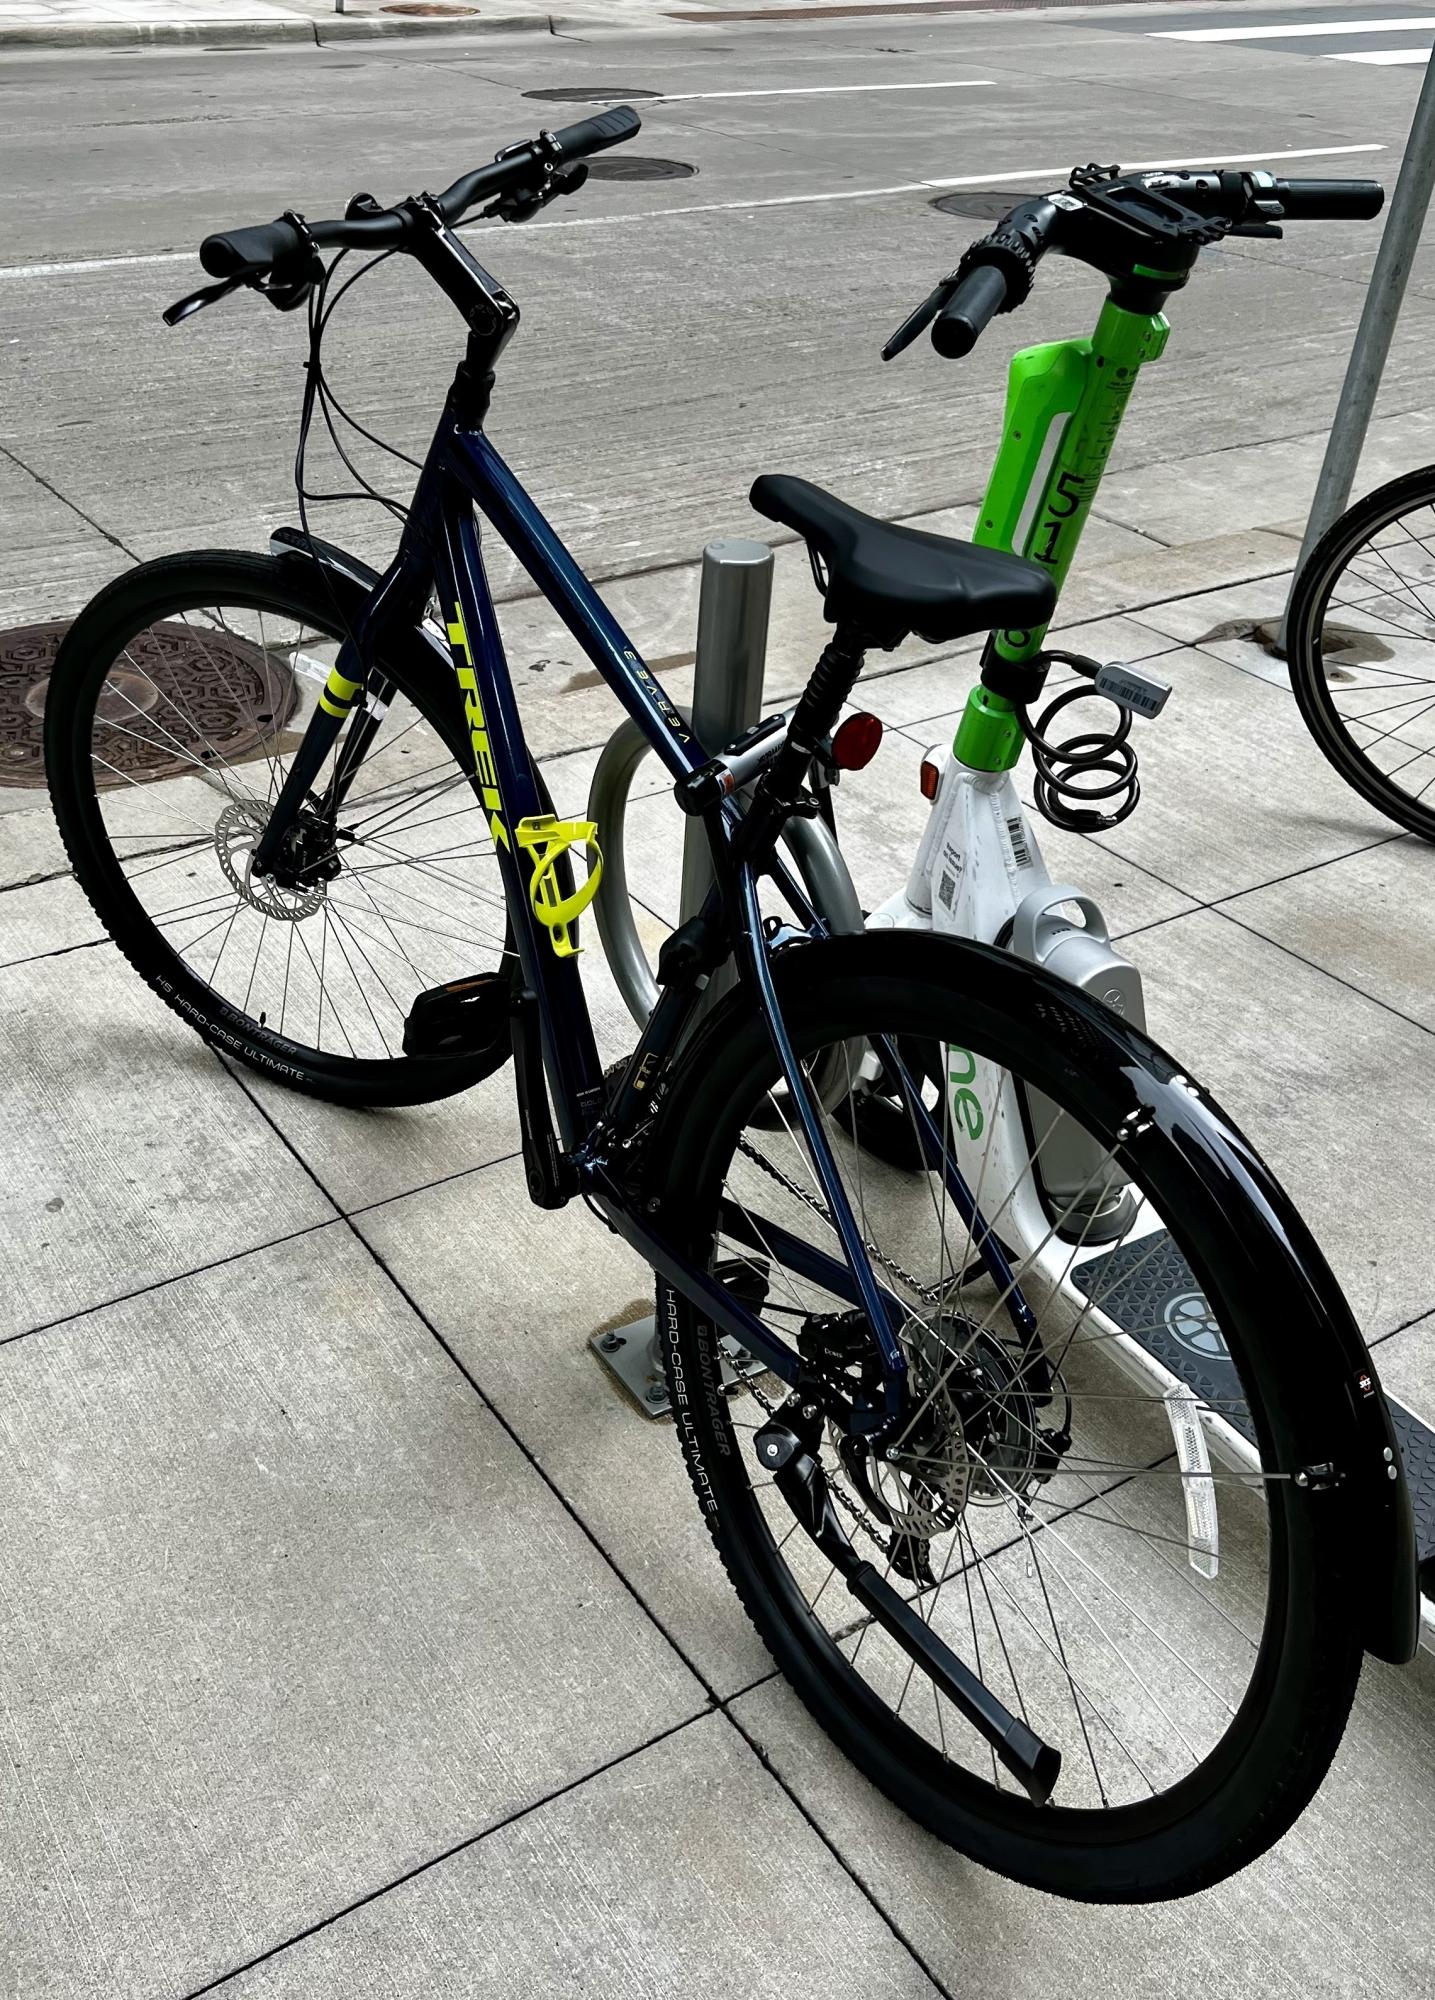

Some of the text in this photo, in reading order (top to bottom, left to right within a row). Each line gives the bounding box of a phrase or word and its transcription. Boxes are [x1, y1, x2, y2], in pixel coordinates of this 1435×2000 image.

[446, 601, 511, 854] TREK
[623, 650, 691, 744] VERVE 3
[174, 993, 244, 1051] HARD-CASE
[243, 1046, 305, 1081] ULTIMATE
[229, 1010, 298, 1056] BONTRAGER
[665, 1288, 719, 1513] HARD-CASE ULTIMATE
[697, 1340, 731, 1456] BONTRAGER
